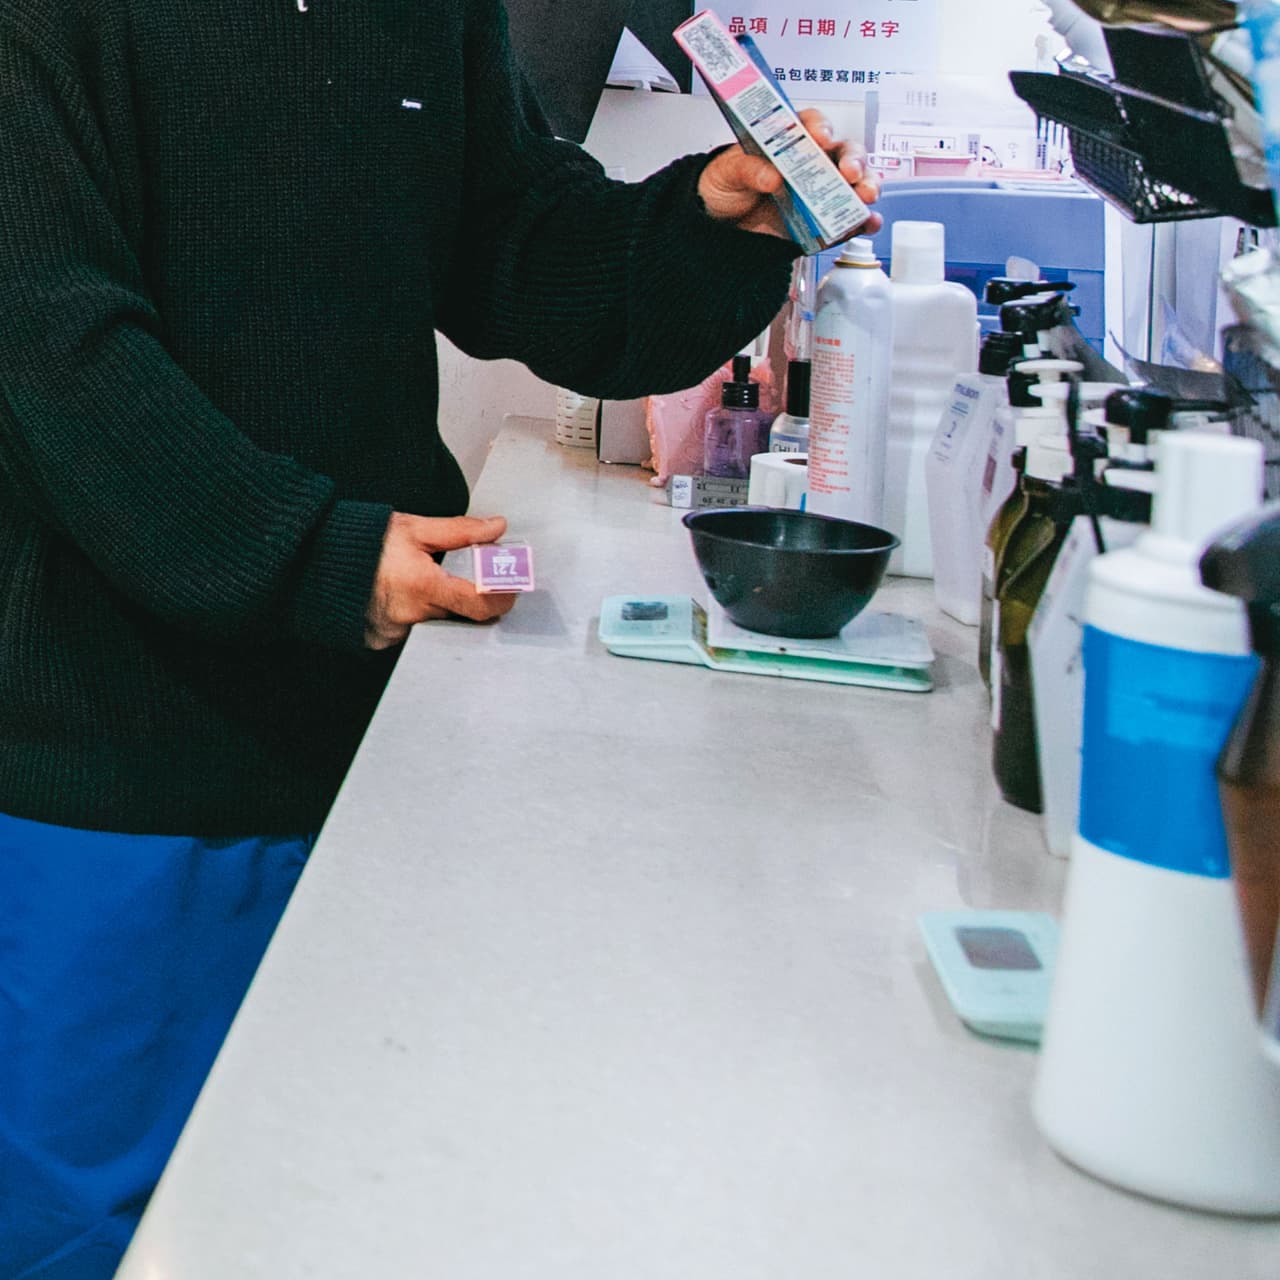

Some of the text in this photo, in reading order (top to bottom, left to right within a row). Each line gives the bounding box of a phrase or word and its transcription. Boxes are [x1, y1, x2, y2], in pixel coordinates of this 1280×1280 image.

[729, 16, 768, 34] 品項
[797, 19, 836, 37] 日期
[860, 20, 900, 38] 名字
